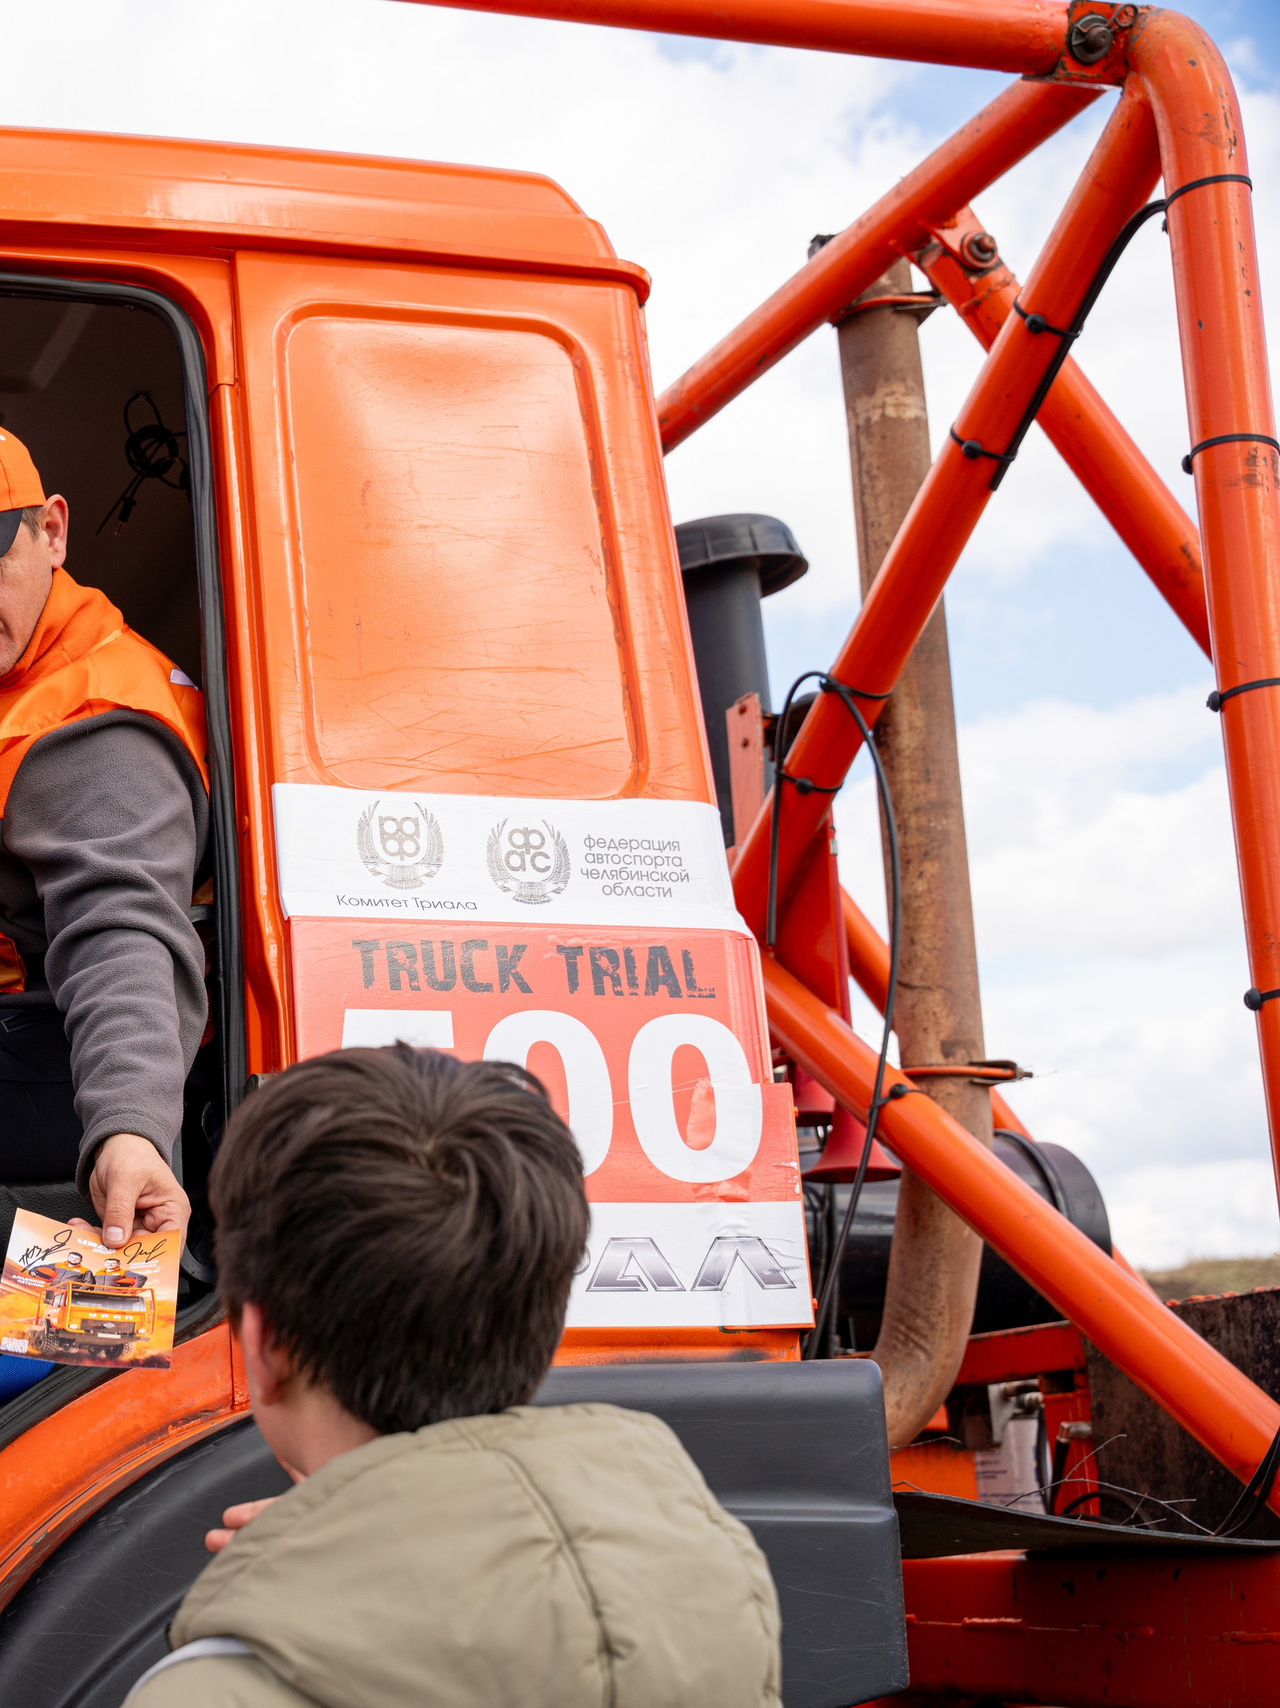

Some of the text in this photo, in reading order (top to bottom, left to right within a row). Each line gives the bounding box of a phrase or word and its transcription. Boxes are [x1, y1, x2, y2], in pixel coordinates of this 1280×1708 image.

[583, 834, 681, 853] федерация
[584, 852, 683, 869] автоспорта
[580, 867, 690, 883] челябинской
[602, 882, 673, 898] области
[336, 895, 478, 911] Комитет Триала
[352, 938, 716, 999] TRUCK TRIAL
[340, 1008, 764, 1183] 00
[574, 1237, 797, 1292] АЛ
